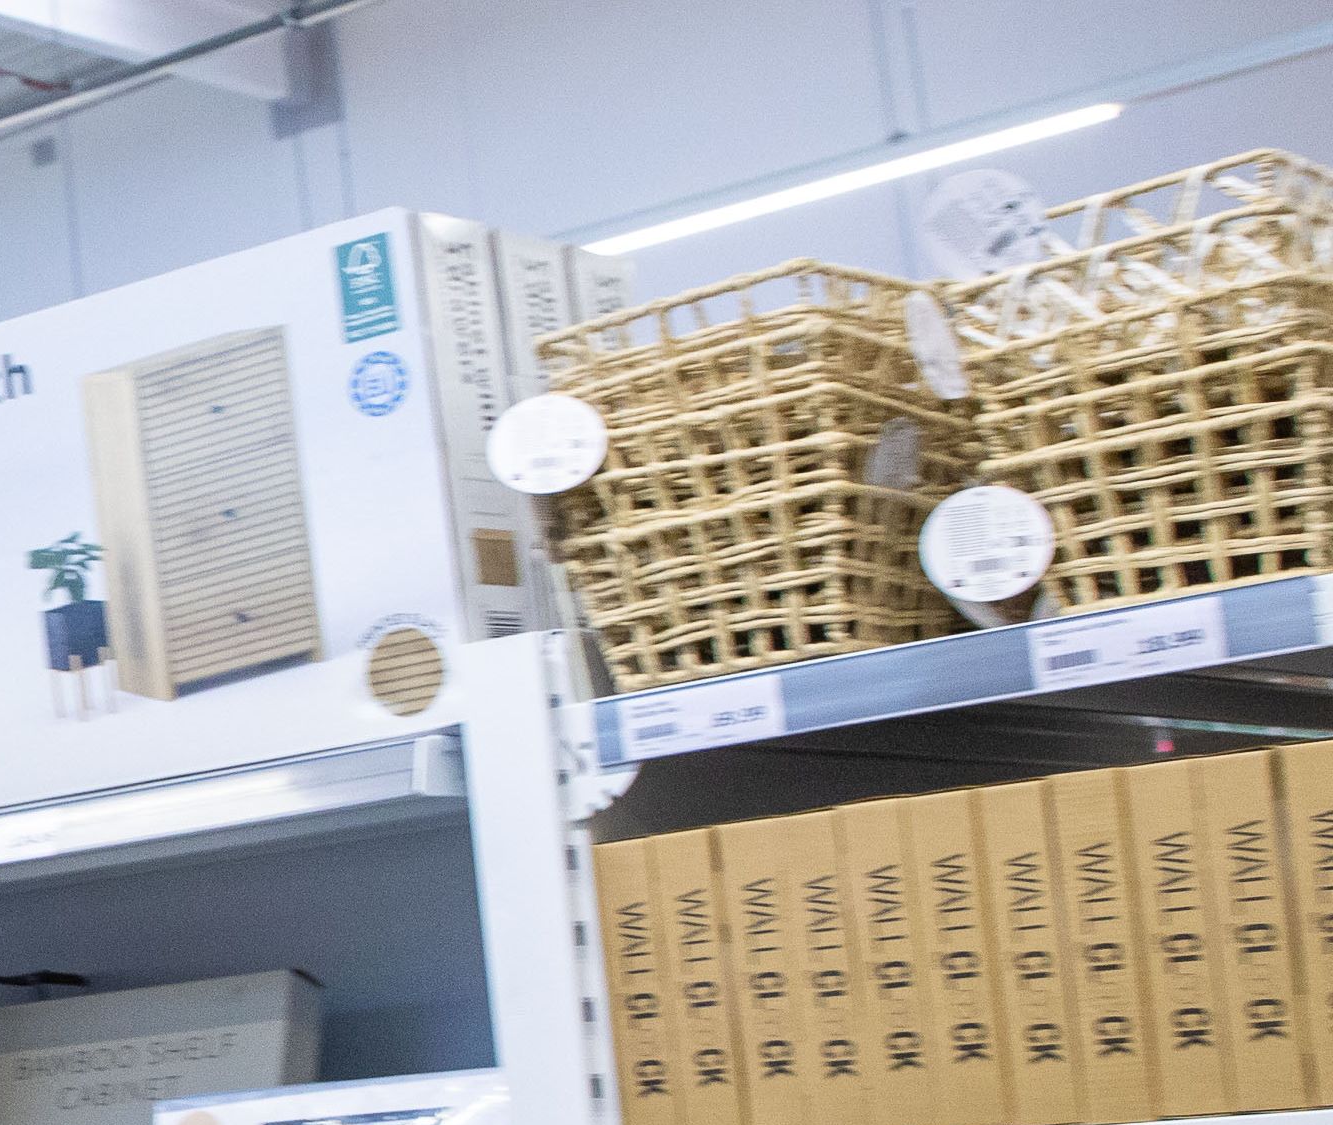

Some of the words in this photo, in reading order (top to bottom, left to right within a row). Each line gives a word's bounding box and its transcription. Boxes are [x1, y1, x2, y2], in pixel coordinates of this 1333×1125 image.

[685, 981, 728, 1087] CLCK
[748, 972, 797, 1079] CLCK
[811, 970, 859, 1079] CLCK
[873, 961, 925, 1071] CLCK
[939, 951, 992, 1063] CLCK
[1013, 951, 1066, 1063] CLCK
[1085, 943, 1133, 1057] CLCK
[1160, 933, 1214, 1050] CLCK
[1234, 923, 1289, 1042] CLCK
[625, 993, 671, 1096] CLCK
